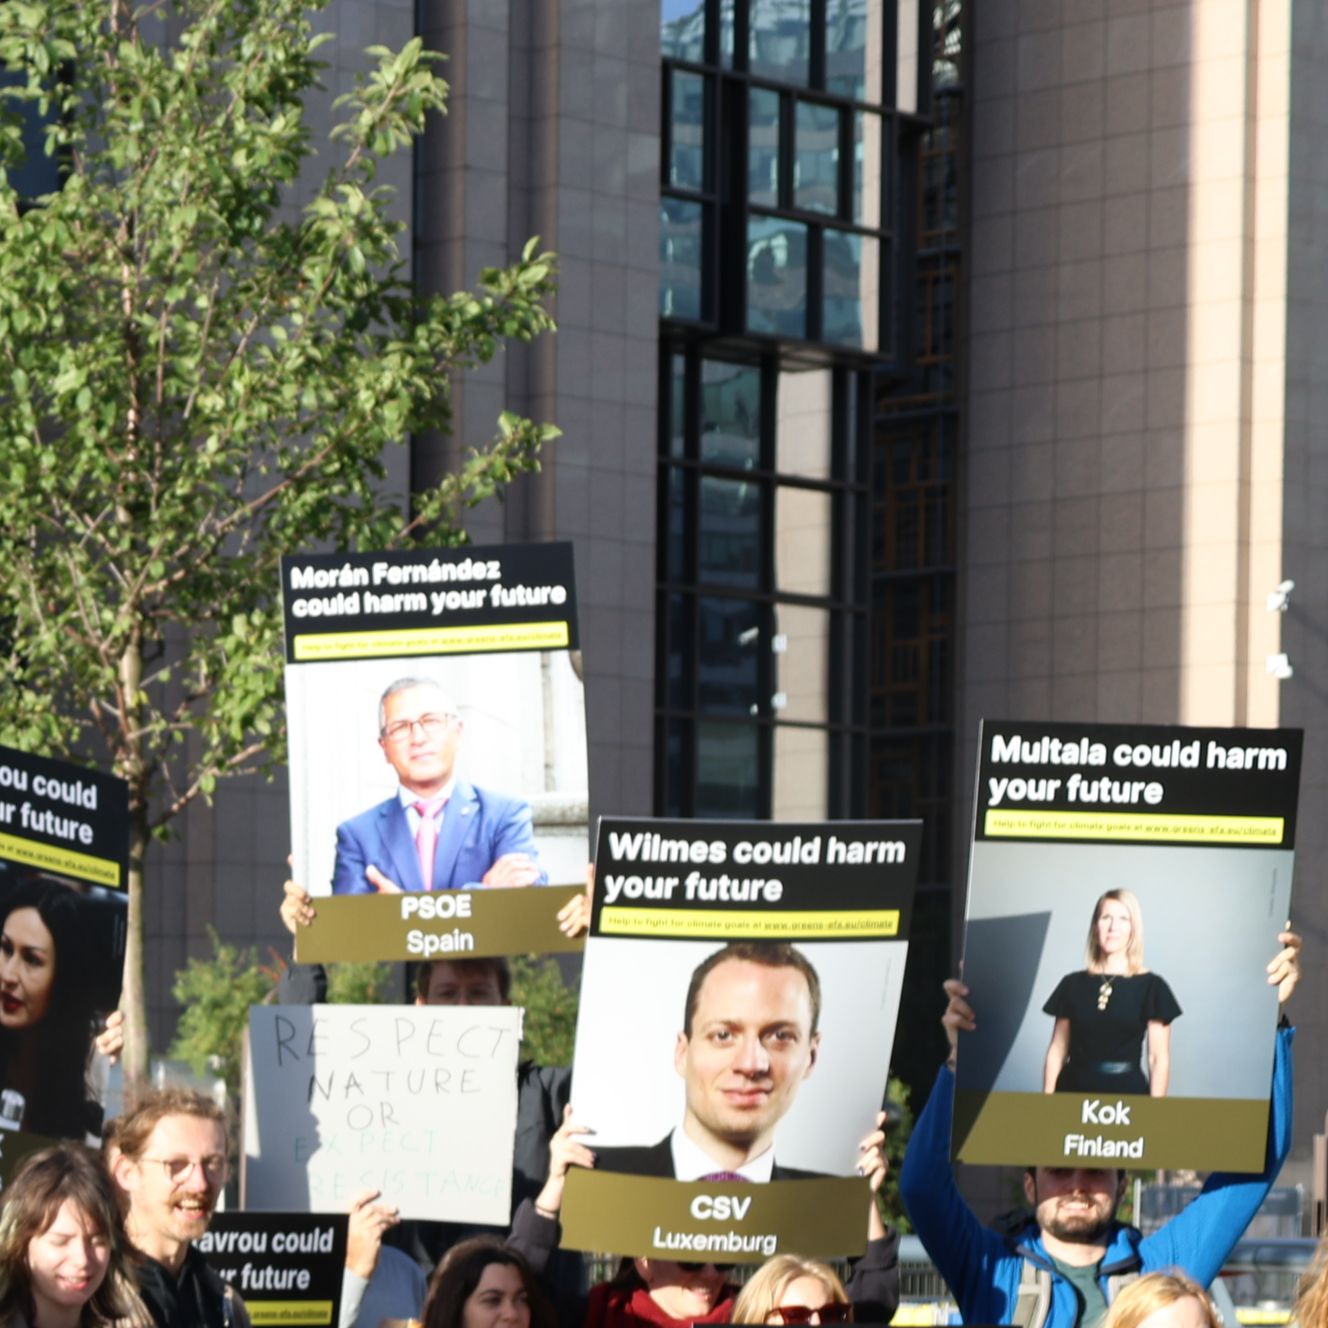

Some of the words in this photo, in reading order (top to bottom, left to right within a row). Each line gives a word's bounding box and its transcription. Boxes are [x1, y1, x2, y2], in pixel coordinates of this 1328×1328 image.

[290, 562, 370, 590] Morán
[372, 557, 502, 586] Fernández
[291, 591, 361, 618] could
[363, 590, 428, 614] harm
[430, 589, 488, 616] your
[489, 583, 567, 608] future
[991, 734, 1107, 766] Multala
[1112, 739, 1201, 768] could
[1206, 740, 1287, 770] harm
[31, 774, 98, 809] could
[608, 832, 727, 864] Wilmes
[732, 836, 822, 865] could
[826, 836, 906, 864] harm
[401, 892, 472, 920] PSOE
[406, 927, 474, 958] Spain
[274, 1014, 512, 1067] RESPECT
[307, 1069, 481, 1103] NATURE
[346, 1101, 400, 1131] OR
[1081, 1099, 1131, 1125] Kok
[1064, 1133, 1144, 1159] Finland
[690, 1194, 752, 1221] CSV
[653, 1226, 778, 1257] Luxemburg
